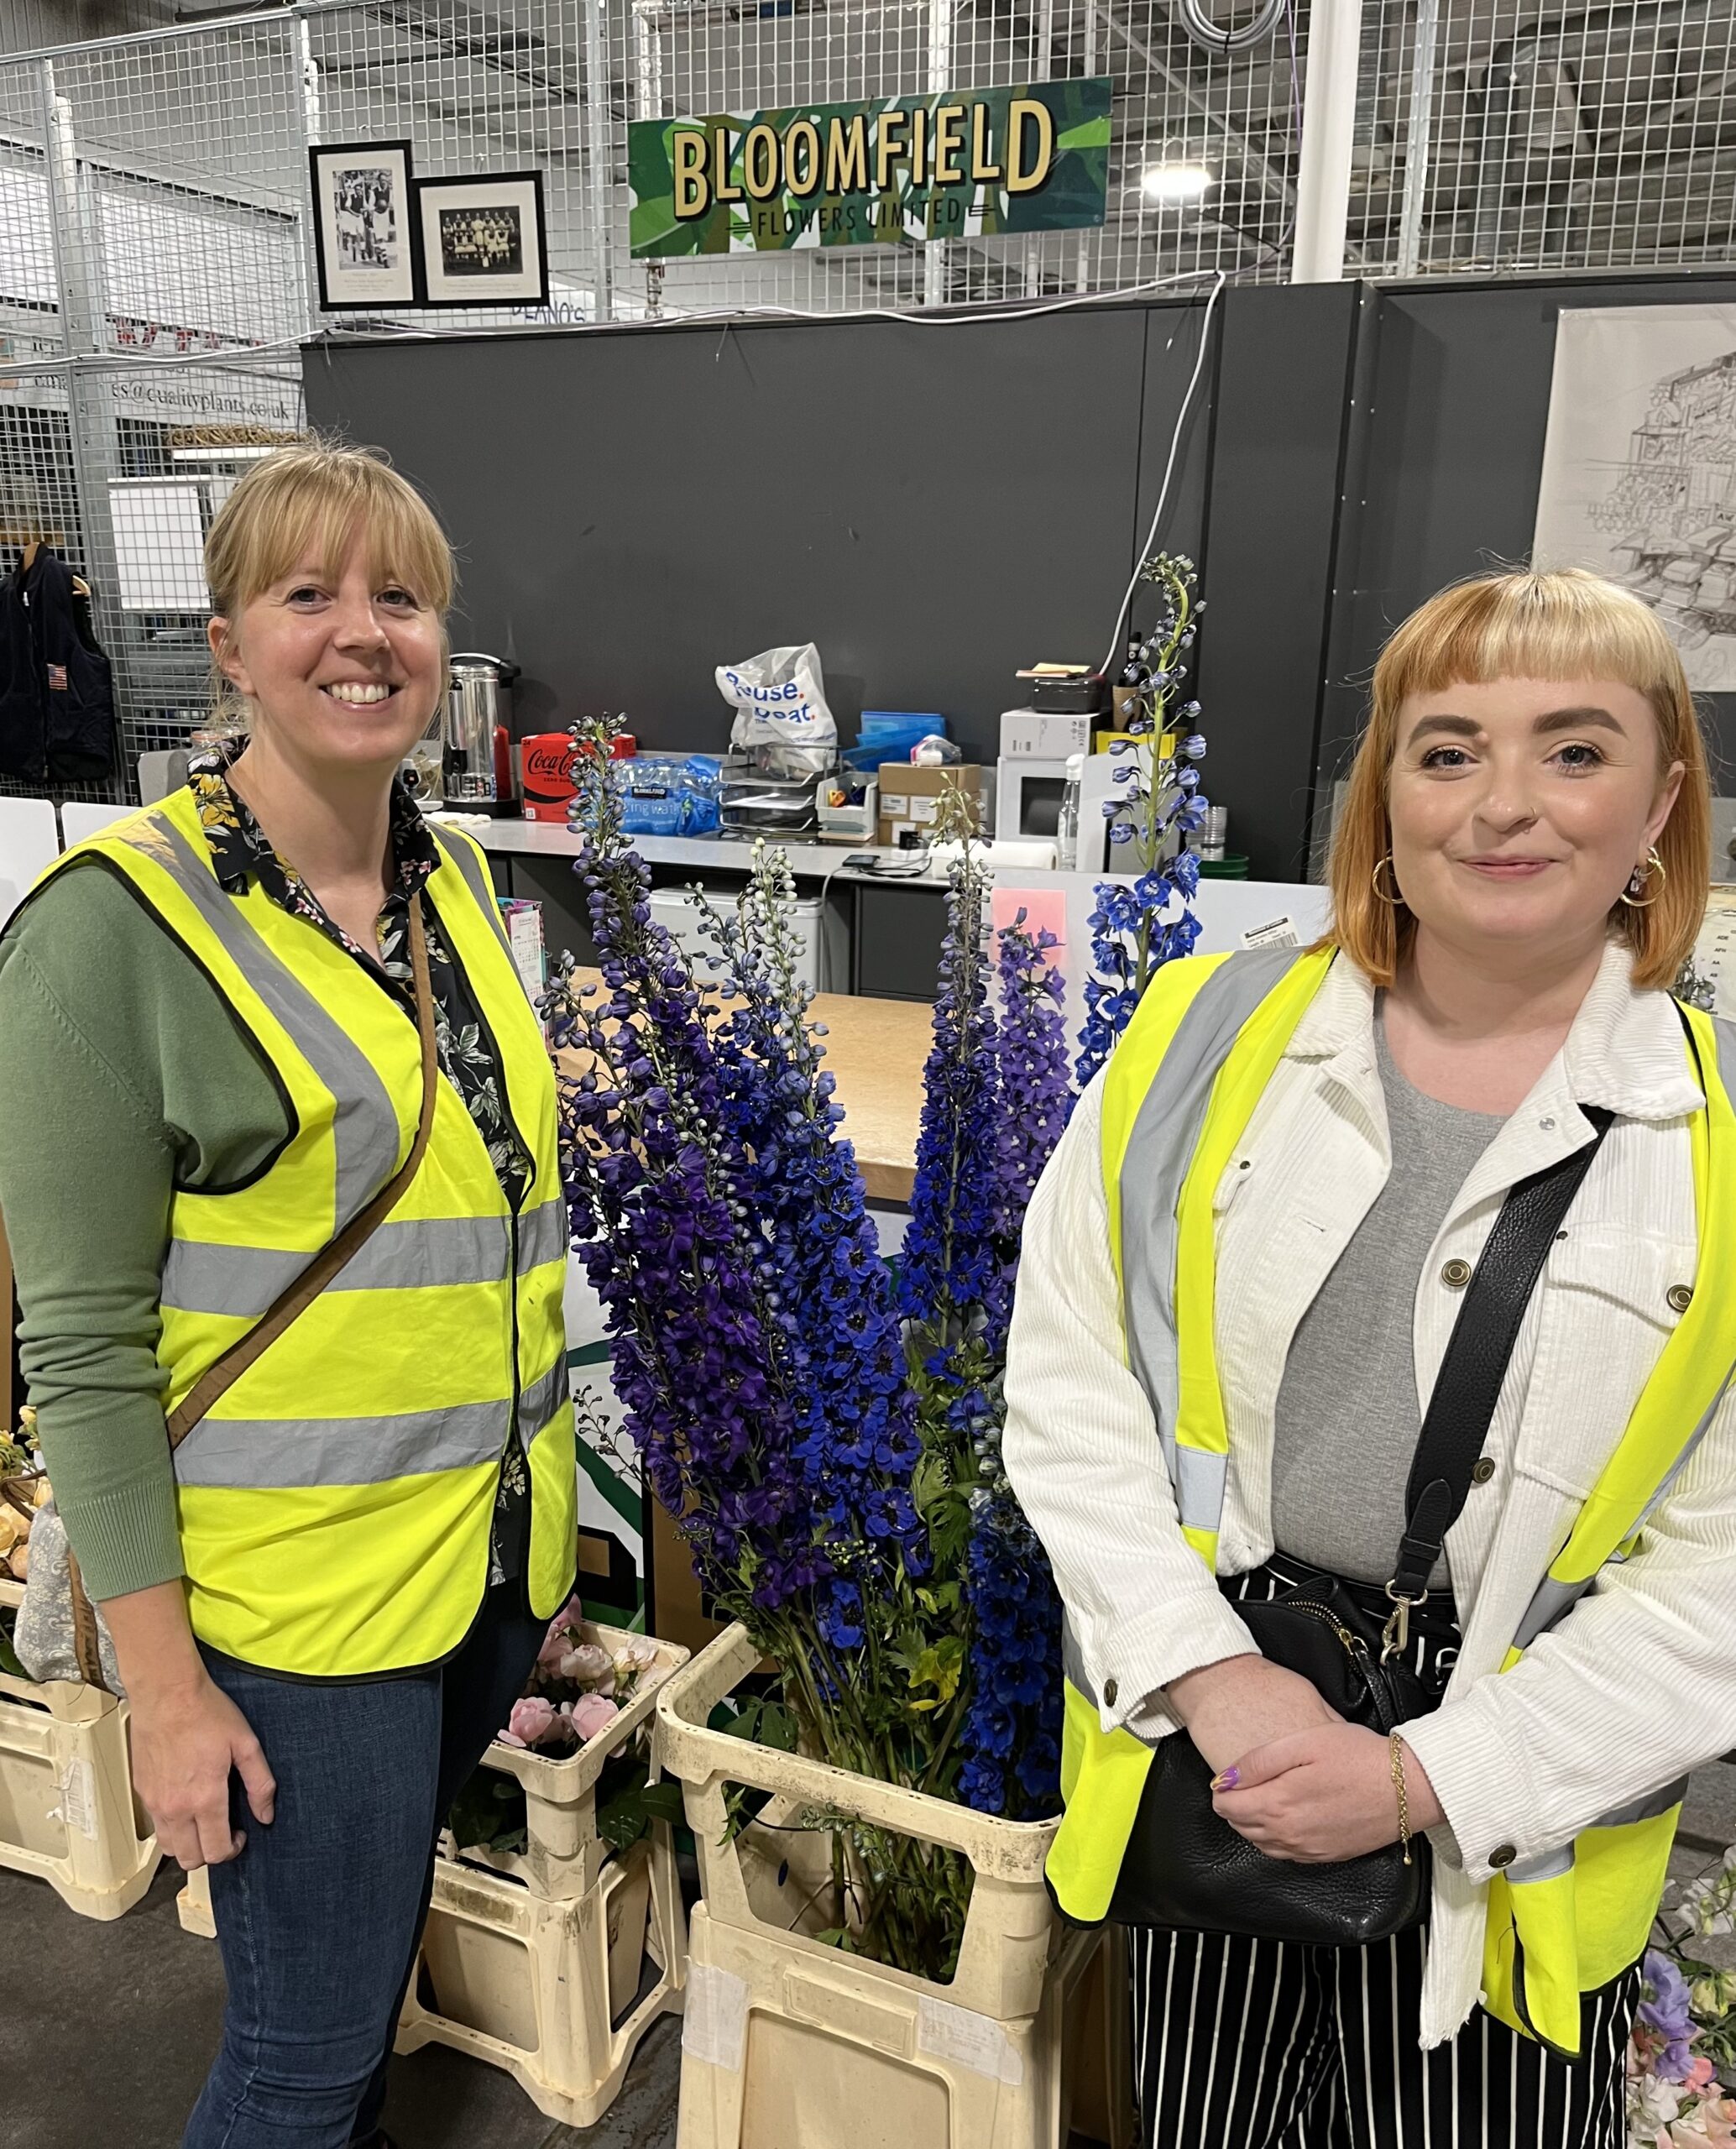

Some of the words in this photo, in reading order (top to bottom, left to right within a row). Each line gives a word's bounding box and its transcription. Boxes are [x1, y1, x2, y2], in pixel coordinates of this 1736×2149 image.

[673, 99, 1057, 222] BLOOMFIELD
[757, 205, 856, 237] FLOWERS
[868, 198, 960, 229] LIMITED
